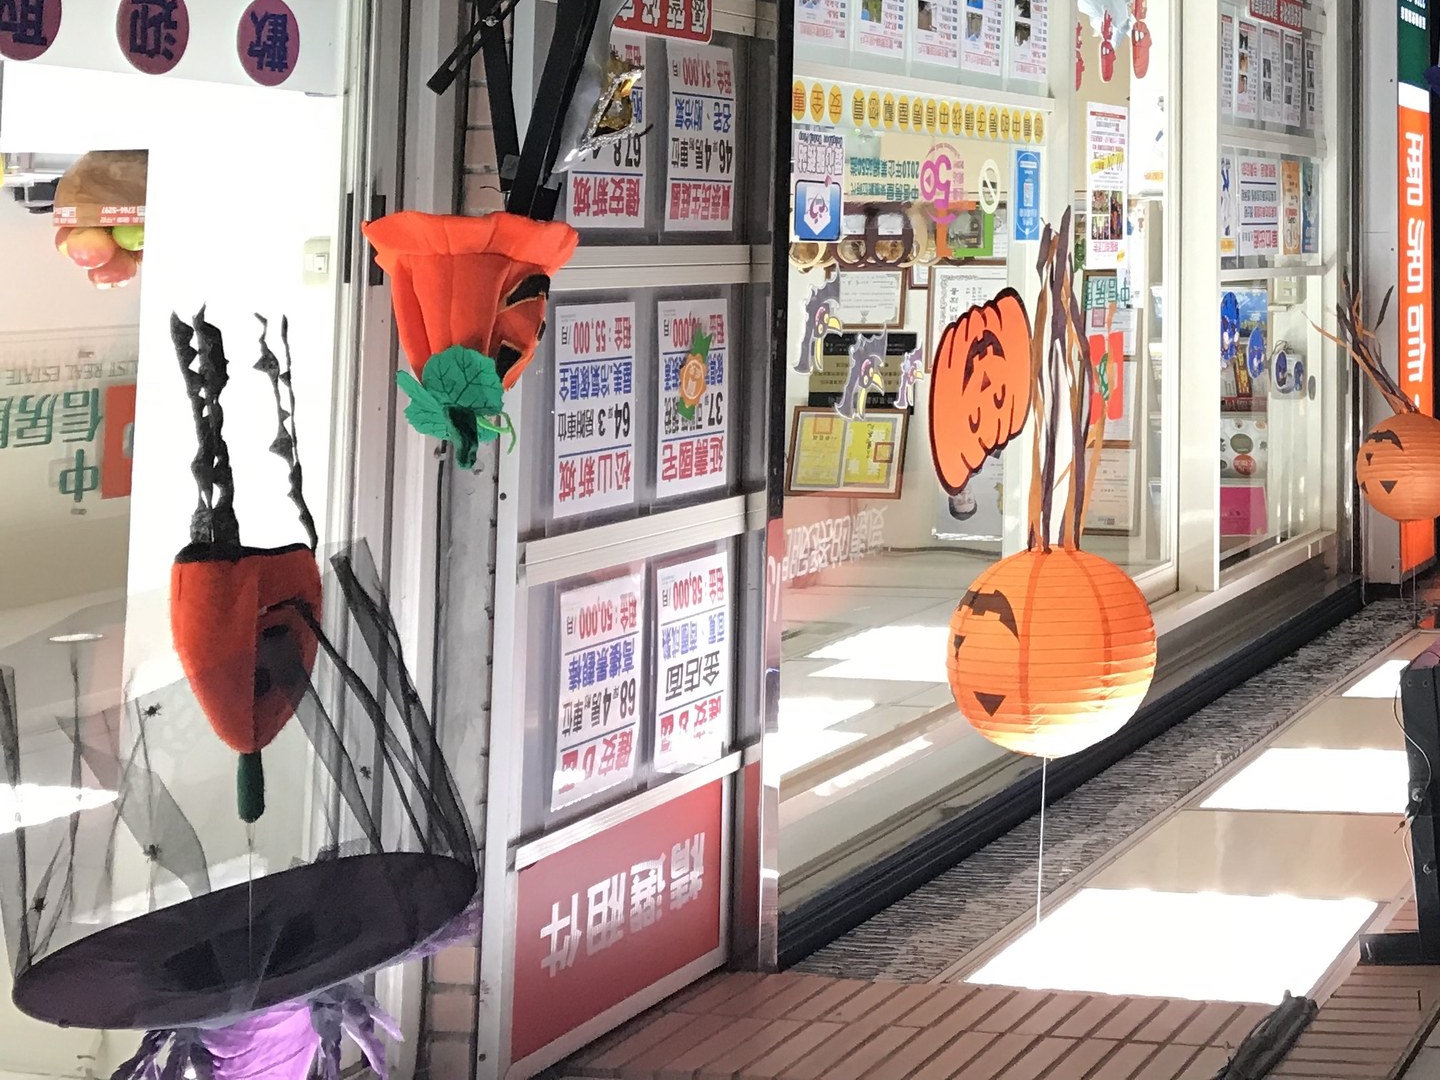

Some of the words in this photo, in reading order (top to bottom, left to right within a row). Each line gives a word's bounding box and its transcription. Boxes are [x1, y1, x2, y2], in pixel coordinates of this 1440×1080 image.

[572, 176, 641, 217] 健安新城
[1405, 132, 1427, 409] 信房屋
[5, 366, 60, 386] ESTATE
[65, 363, 103, 381] REAL
[0, 388, 103, 449] 信房
[58, 449, 99, 503] 中
[558, 452, 631, 502] 松山新城
[661, 436, 724, 482] 延壽國宅
[567, 639, 636, 692] 高樓景觀棒
[665, 650, 720, 701] 金店面
[539, 832, 706, 977] 精選租件
